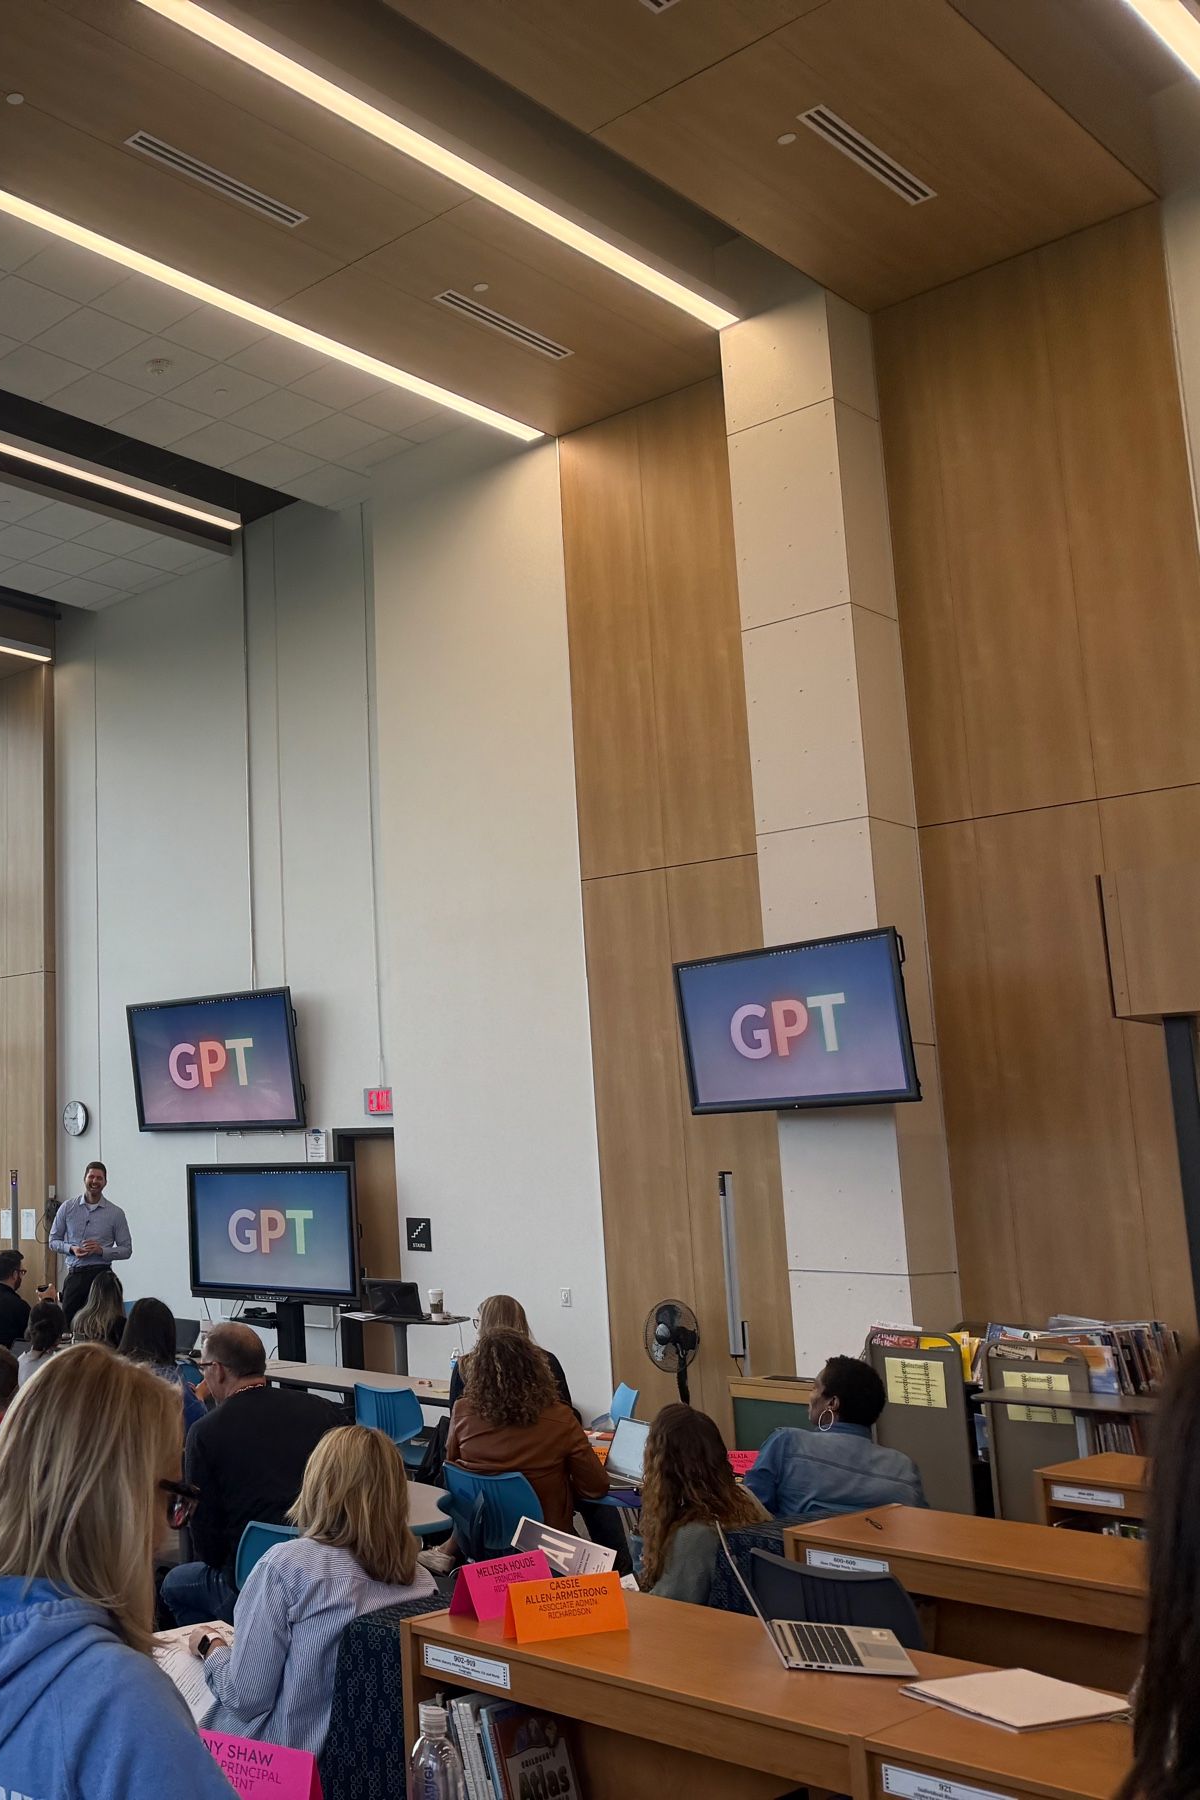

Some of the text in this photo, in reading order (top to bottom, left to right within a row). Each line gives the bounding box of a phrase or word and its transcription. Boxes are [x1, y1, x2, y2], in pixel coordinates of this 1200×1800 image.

[730, 992, 846, 1060] GPT
[168, 1038, 254, 1089] GPT
[228, 1208, 313, 1255] GPT
[537, 1533, 577, 1571] AI
[476, 1556, 536, 1579] MELISSA HOUDE
[495, 1573, 525, 1584] PRINCIPAL
[525, 1586, 608, 1606] ALLEN-ARMSTRONG
[549, 1578, 580, 1591] CASSIE
[538, 1598, 598, 1612] ASSOCIATE ADMIN
[548, 1607, 592, 1620] RICHARDSON
[227, 1744, 274, 1767] SHAW
[221, 1760, 282, 1784] PRINCIPAL
[518, 1763, 571, 1800] Atlas
[938, 1783, 952, 1793] 921
